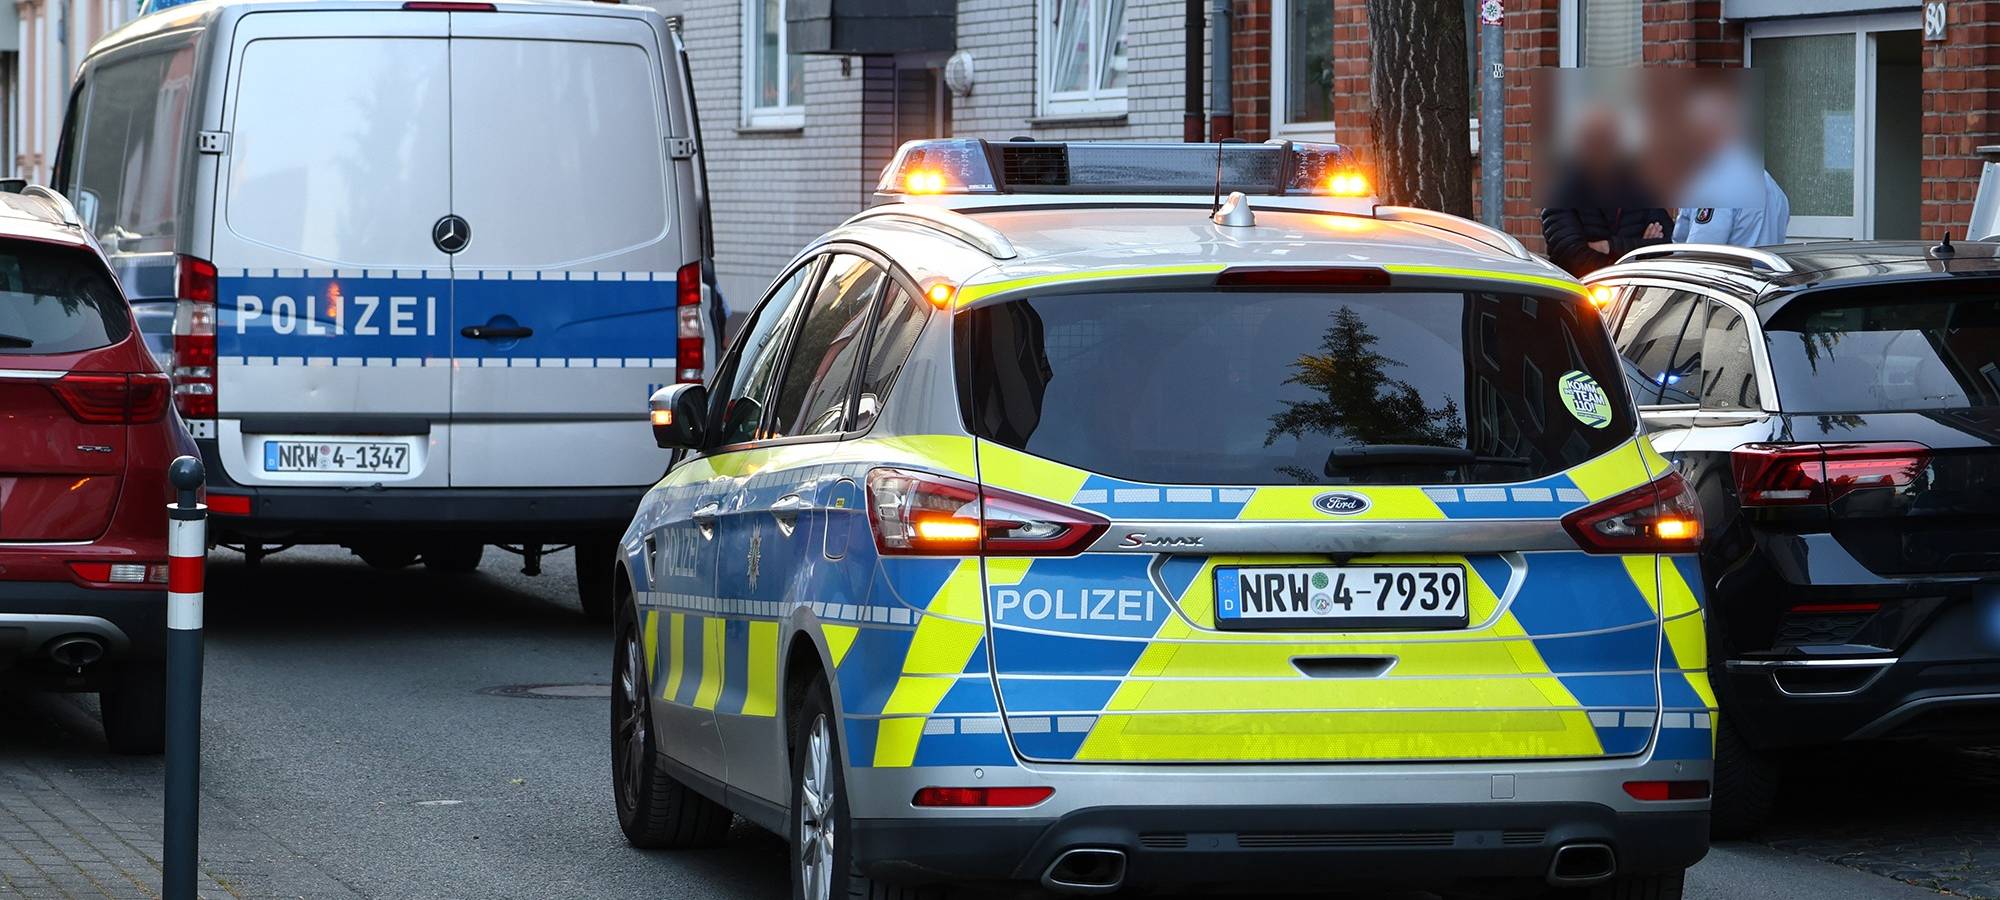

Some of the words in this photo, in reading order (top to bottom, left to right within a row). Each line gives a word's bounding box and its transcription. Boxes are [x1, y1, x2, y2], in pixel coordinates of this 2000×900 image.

[1925, 3, 1946, 36] 80
[236, 295, 436, 336] POLIZEI
[1567, 380, 1597, 394] KOMM
[1574, 390, 1605, 405] TEAM
[1574, 400, 1596, 413] 110!
[279, 445, 318, 468] NRW
[333, 446, 406, 469] 4-1347
[1327, 496, 1357, 509] Ford
[663, 528, 700, 577] POLIZEI
[1118, 532, 1204, 549] S-MAX
[996, 588, 1154, 621] POLIZEI
[1224, 599, 1234, 611] D
[1240, 573, 1309, 613] NRW
[1333, 572, 1461, 612] 4-7939
